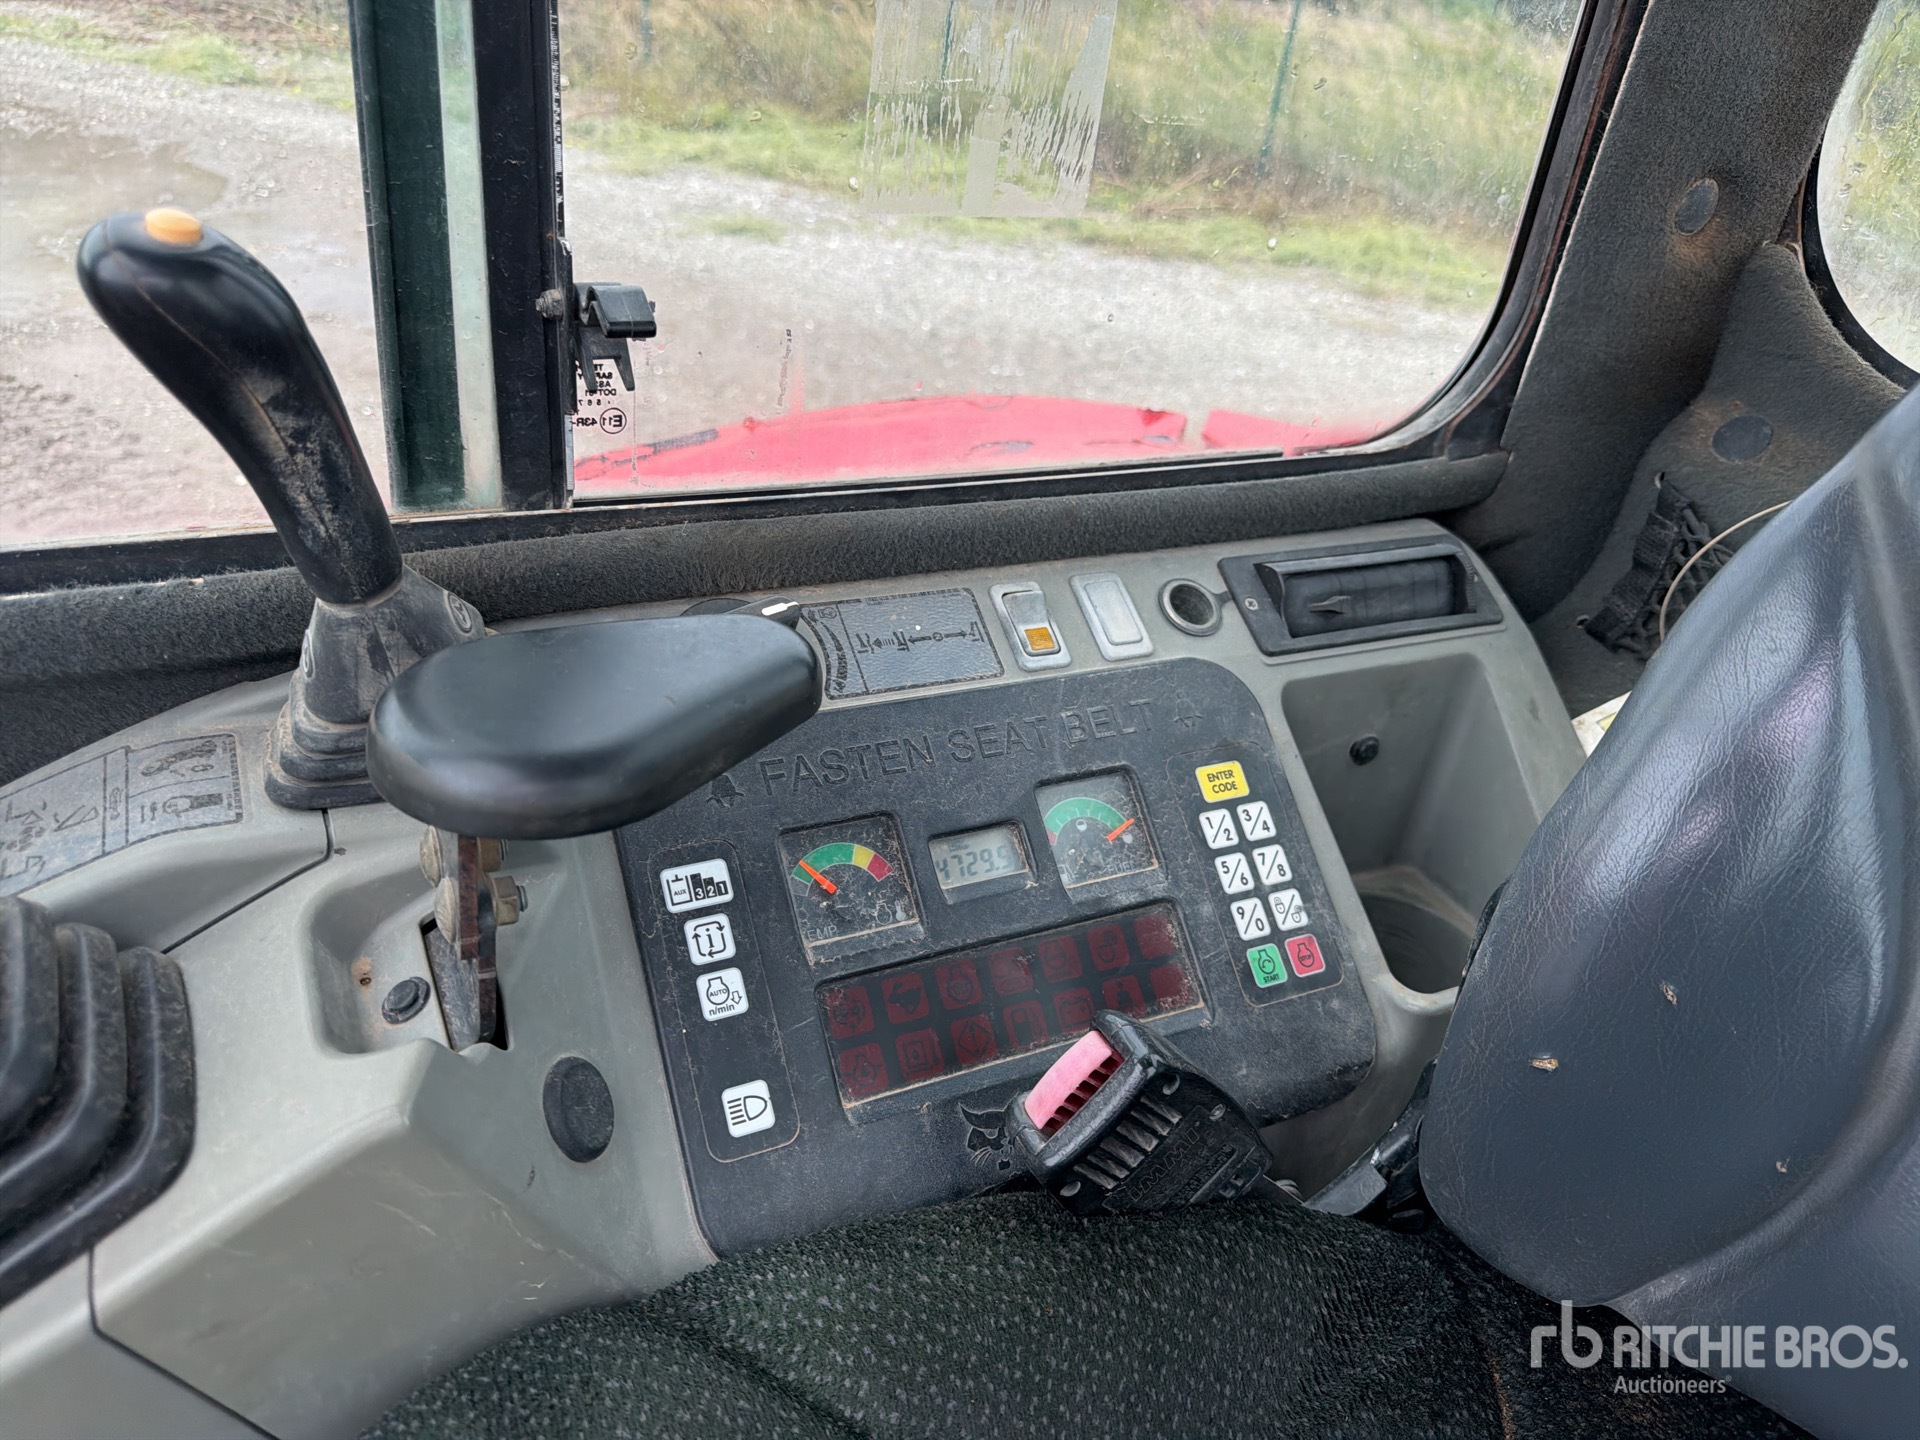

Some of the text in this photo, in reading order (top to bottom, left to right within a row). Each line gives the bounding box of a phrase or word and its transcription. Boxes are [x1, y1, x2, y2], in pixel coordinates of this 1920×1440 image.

[758, 699, 1154, 795] FASTEN SEAT BELT
[1206, 769, 1236, 783] ENTER
[1211, 780, 1239, 794] CODE
[673, 888, 687, 897] AUX
[1263, 973, 1280, 984] START
[709, 988, 728, 998] AUTO
[708, 1003, 736, 1016] n/min
